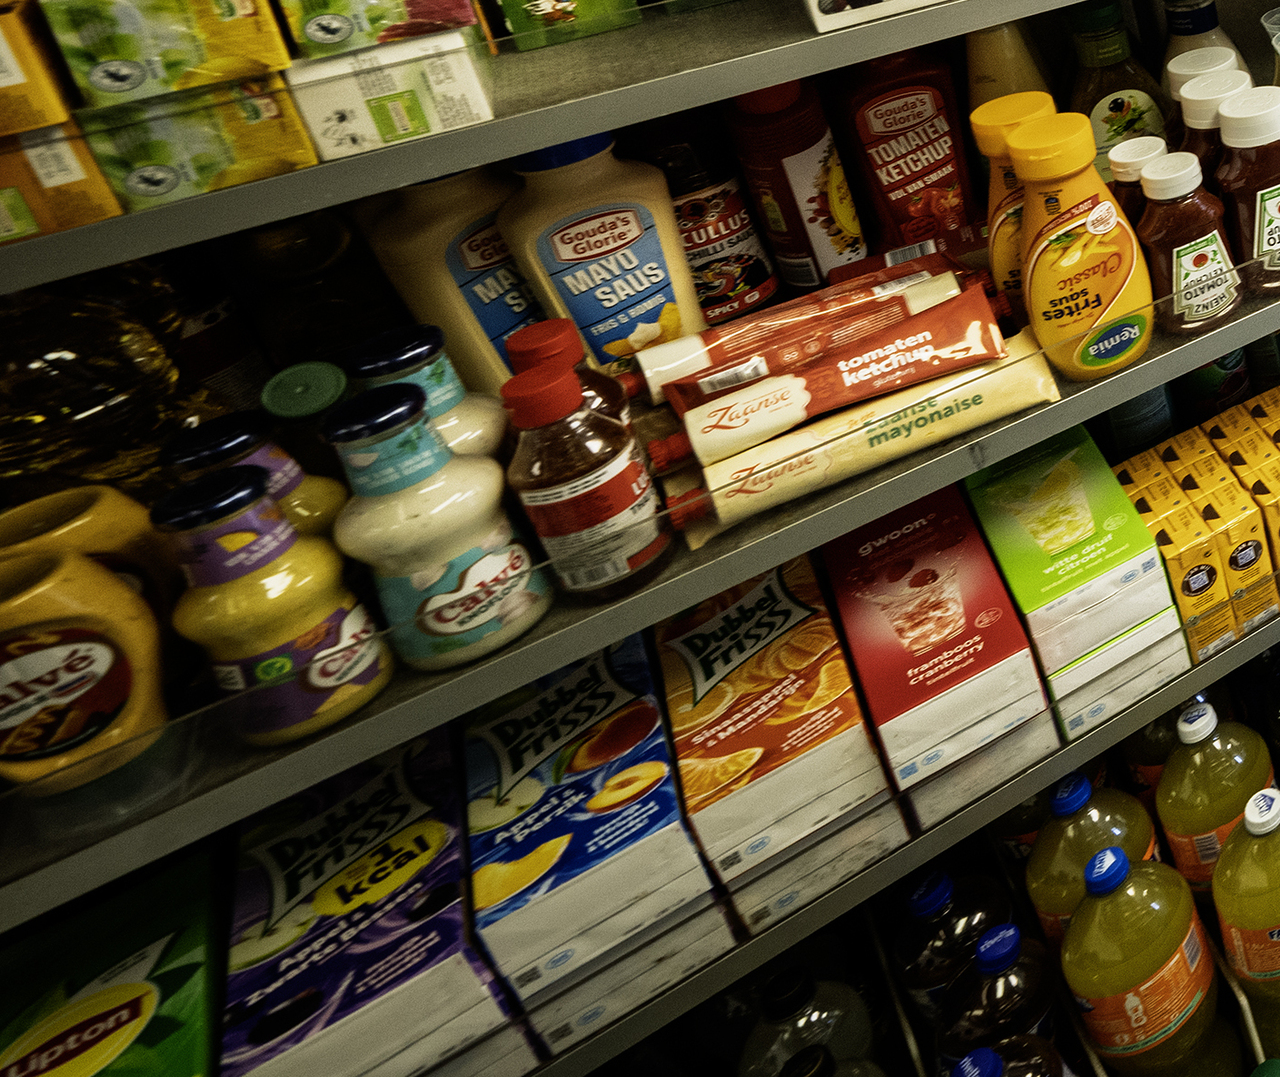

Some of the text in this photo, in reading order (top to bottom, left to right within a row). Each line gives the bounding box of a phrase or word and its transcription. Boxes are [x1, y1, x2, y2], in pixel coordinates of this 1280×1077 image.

[872, 95, 927, 121] Gouda's
[882, 108, 926, 131] Glorie
[868, 120, 950, 162] TOMATEN
[877, 137, 954, 186] KETCHUP
[559, 214, 632, 245] Gouda's
[572, 228, 628, 256] Glorie
[563, 252, 640, 296] MAYO
[595, 263, 667, 311] SAUS
[1059, 252, 1122, 291] Classic
[1184, 276, 1229, 301] TOMATO
[706, 302, 740, 319] SPICY
[1042, 293, 1102, 322] Frites
[1048, 288, 1089, 307] saus
[1194, 294, 1227, 314] HEINZ
[837, 330, 932, 371] tomaten
[1088, 324, 1139, 356] Remia
[842, 344, 934, 387] ketchup
[707, 385, 794, 434] Zaanse
[866, 391, 985, 448] mayonaise
[1042, 553, 1078, 574] witte
[1081, 534, 1113, 558] druif
[1057, 546, 1107, 576] citroen
[682, 585, 777, 652] Dubbel
[906, 634, 982, 679] framboos
[908, 641, 985, 686] cranberry
[500, 662, 602, 743] Dubbel
[268, 770, 399, 870] Dubbel
[333, 833, 432, 906] kcal
[5, 1006, 130, 1077] Lipton
